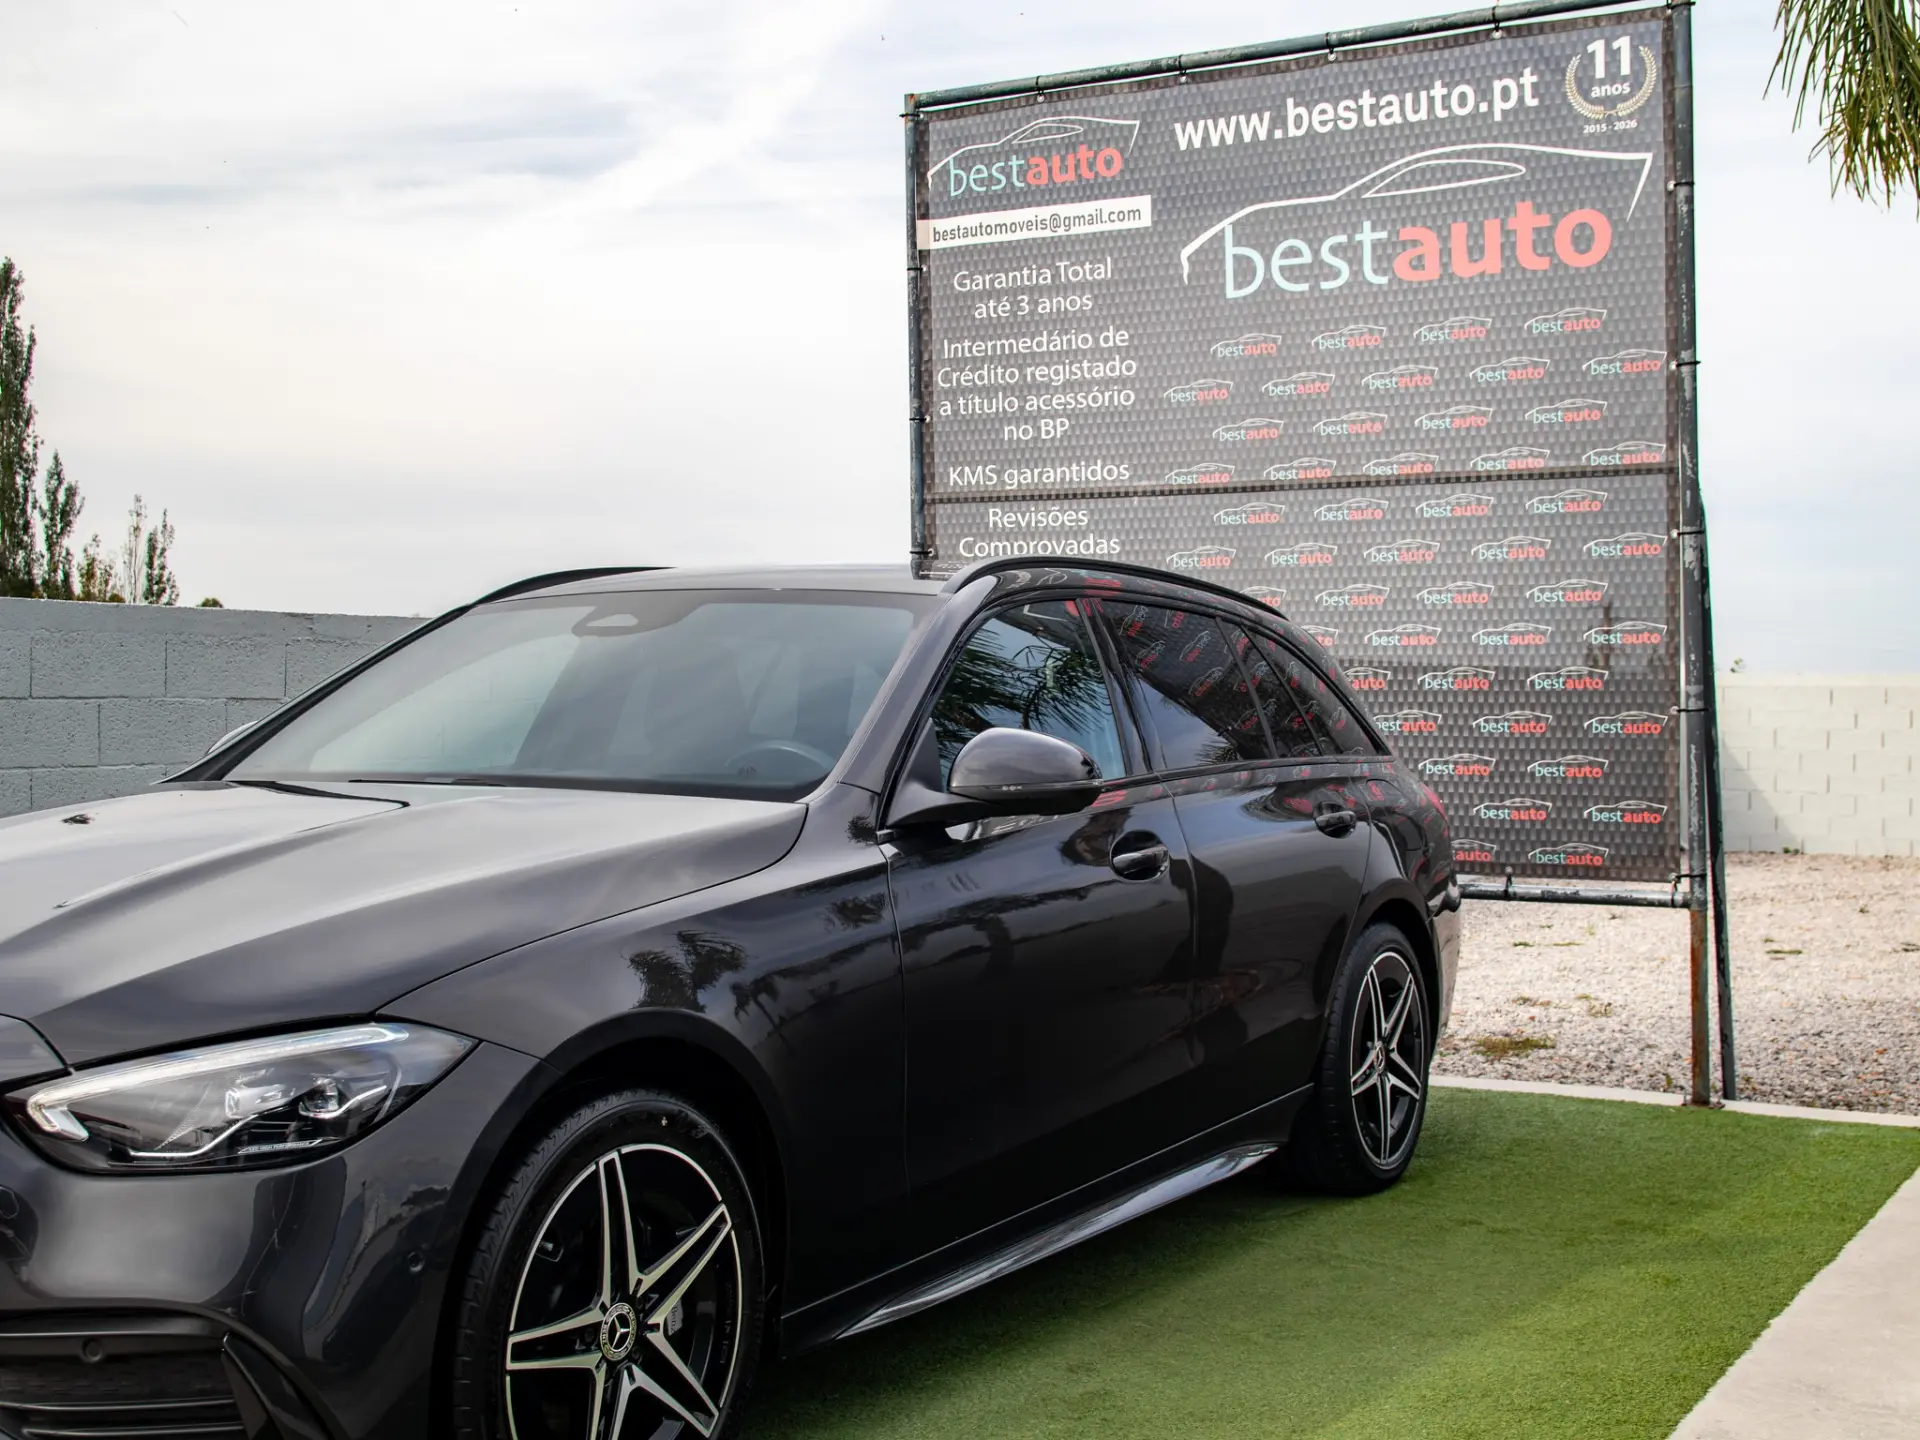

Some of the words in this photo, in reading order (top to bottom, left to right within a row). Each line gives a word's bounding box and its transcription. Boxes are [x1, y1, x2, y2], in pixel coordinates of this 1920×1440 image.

[1587, 36, 1631, 79] 11
[1591, 83, 1630, 98] anos
[1174, 68, 1539, 150] www.bestauto.pt
[950, 144, 1122, 196] bestauto
[933, 208, 1141, 243] bestautomoveis@gmail.com
[1224, 201, 1612, 299] bestauto
[954, 264, 1051, 291] Garantia
[1056, 257, 1112, 282] Total
[975, 298, 1011, 318] até
[1017, 296, 1029, 315] 3
[1038, 294, 1092, 313] anos
[1533, 319, 1600, 333] bestauto
[1422, 327, 1486, 342] bestauto
[944, 330, 1092, 359] Intermedário
[1100, 326, 1129, 348] de
[1319, 335, 1381, 349] bestauto
[1218, 343, 1276, 357] bestauto
[938, 364, 1019, 387] Crédito
[1027, 356, 1136, 386] registado
[1478, 367, 1544, 382] bestauto
[1591, 361, 1661, 375] bestauto
[1369, 374, 1432, 389] bestauto
[1171, 389, 1228, 402] bestauto
[1269, 382, 1329, 396] bestauto
[940, 400, 952, 416] a
[958, 392, 1019, 414] título
[1025, 387, 1135, 410] acessório
[1423, 416, 1487, 430] bestauto
[1533, 410, 1601, 424] bestauto
[1004, 422, 1033, 441] no
[1040, 418, 1069, 439] BP
[1220, 428, 1278, 441] bestauto
[1320, 422, 1382, 435] bestauto
[1477, 458, 1544, 471] bestauto
[1591, 452, 1660, 466] bestauto
[950, 466, 997, 486] KMS
[1004, 460, 1130, 488] garantidos
[1270, 467, 1331, 480] bestauto
[1370, 462, 1433, 475] bestauto
[1172, 472, 1230, 485] bestauto
[1423, 504, 1488, 518] bestauto
[1534, 499, 1601, 513] bestauto
[989, 507, 1088, 528] Revisões
[1221, 511, 1279, 525] bestauto
[1321, 507, 1383, 521] bestauto
[959, 533, 1120, 557] Comprovadas
[1592, 543, 1661, 556] bestauto
[1272, 552, 1332, 565] bestauto
[1371, 549, 1434, 562] bestauto
[1480, 546, 1545, 560] bestauto
[1174, 555, 1231, 568] bestauto
[1323, 592, 1384, 606] bestauto
[1424, 590, 1488, 604] bestauto
[1534, 589, 1602, 602] bestauto
[1372, 632, 1436, 646] bestauto
[1480, 632, 1545, 646] bestauto
[1591, 630, 1661, 645] bestauto
[1425, 676, 1489, 689] bestauto
[1535, 675, 1602, 689] bestauto
[1480, 719, 1546, 733] bestauto
[1592, 720, 1661, 734] bestauto
[1426, 761, 1490, 776] bestauto
[1535, 763, 1603, 778] bestauto
[1481, 806, 1547, 820] bestauto
[1592, 808, 1661, 824] bestauto
[1536, 850, 1603, 866] bestauto
